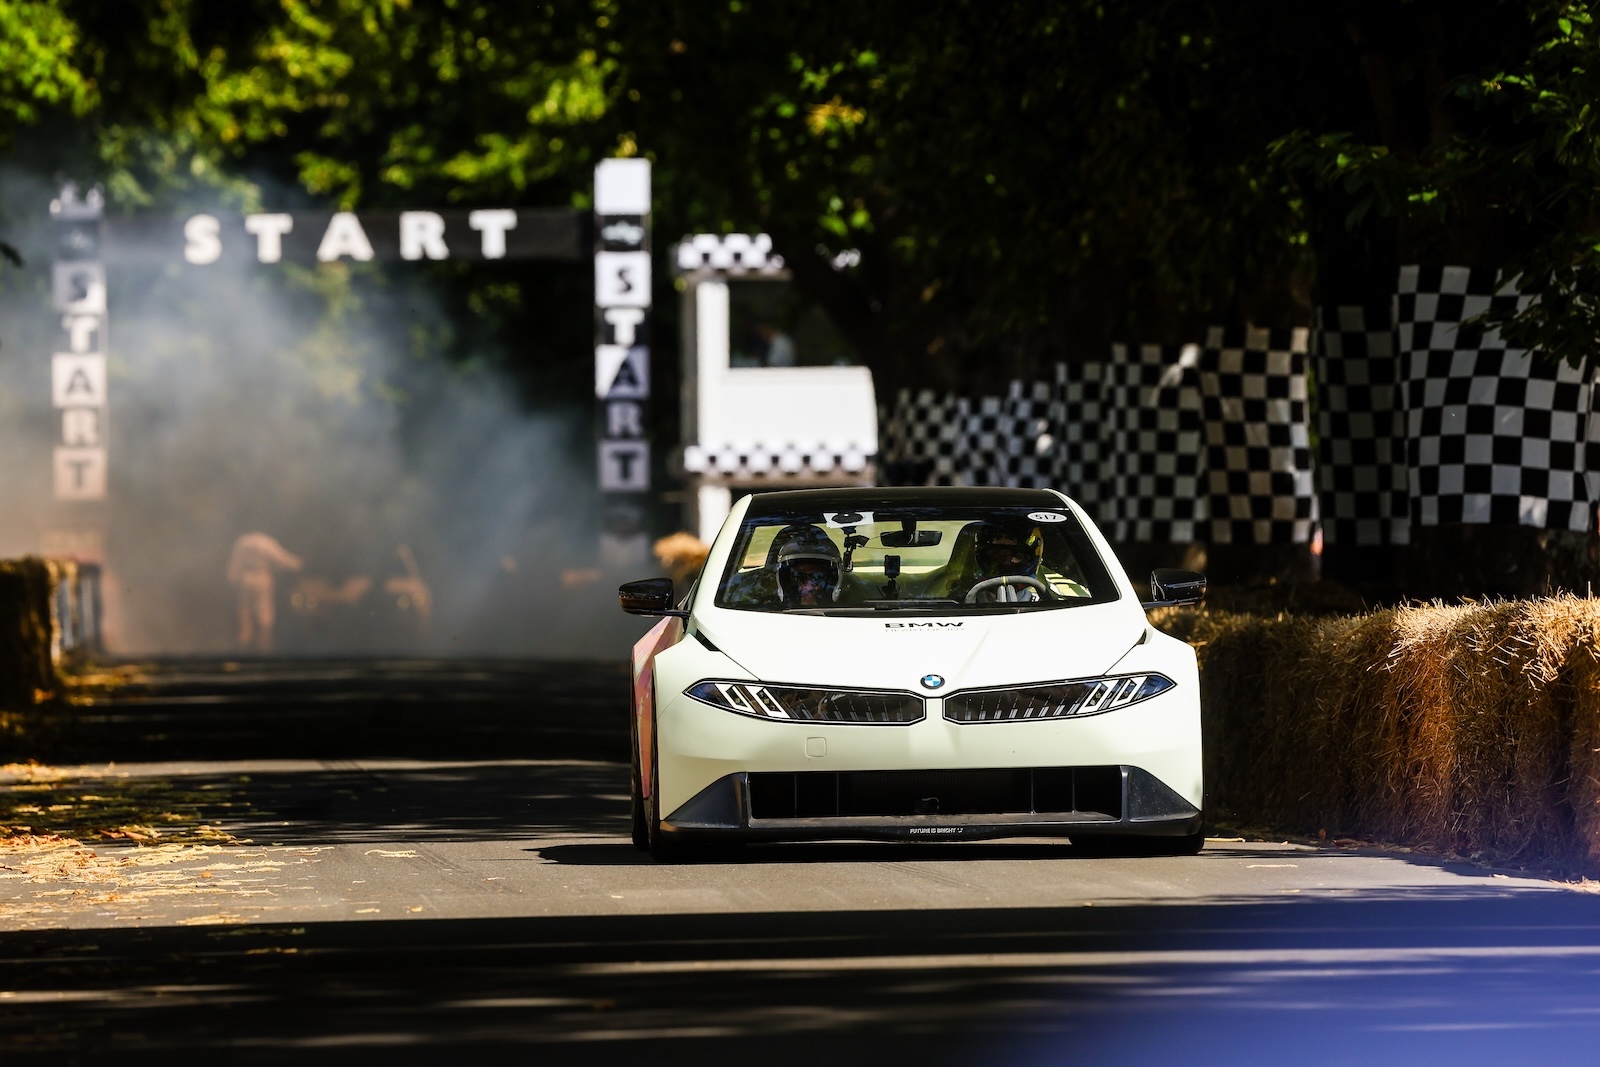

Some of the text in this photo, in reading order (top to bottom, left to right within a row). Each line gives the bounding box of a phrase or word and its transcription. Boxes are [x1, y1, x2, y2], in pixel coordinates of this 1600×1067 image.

[184, 209, 517, 264] START
[62, 267, 99, 490] START
[603, 264, 645, 482] START
